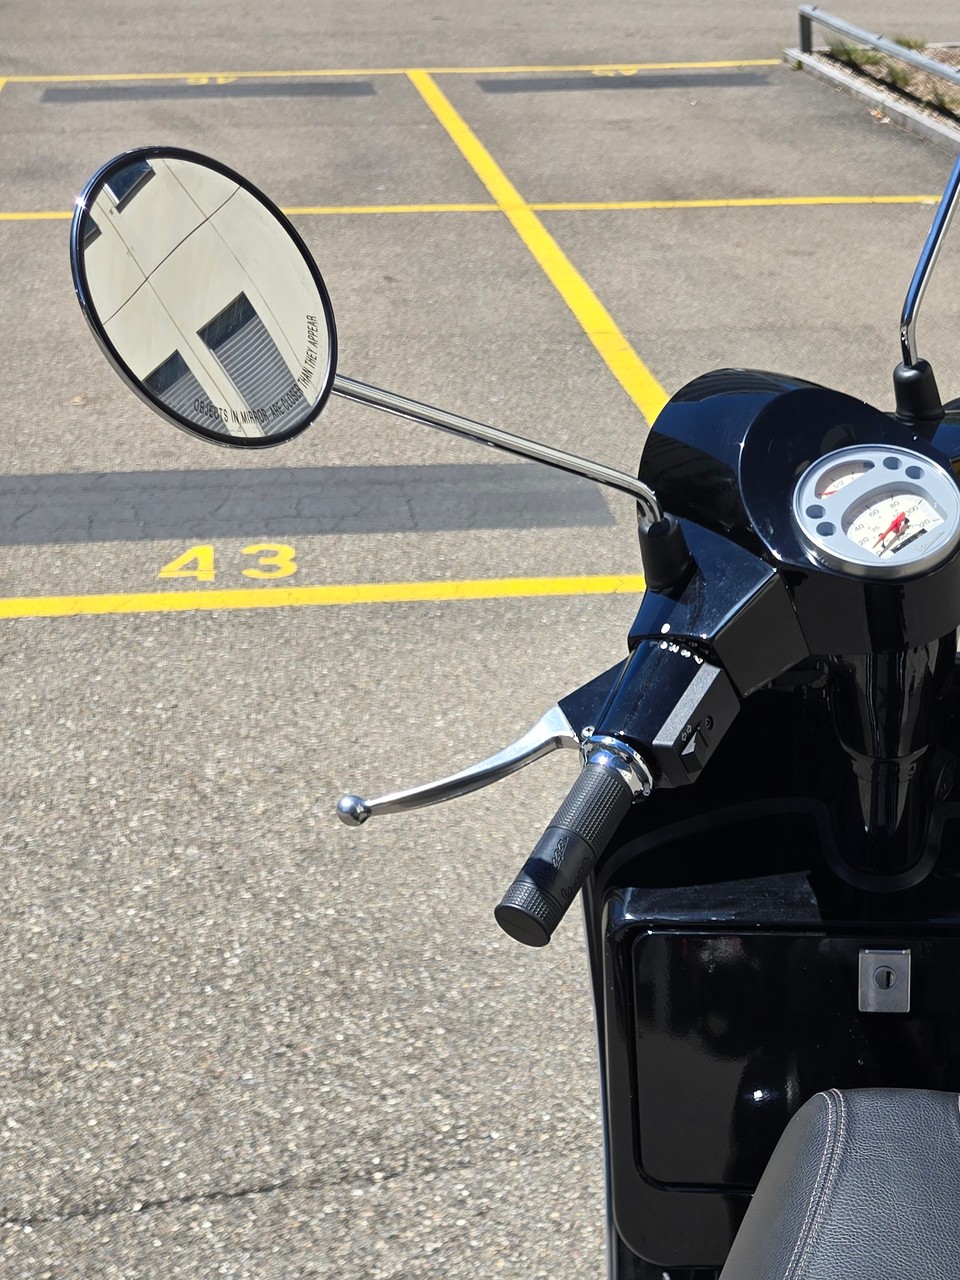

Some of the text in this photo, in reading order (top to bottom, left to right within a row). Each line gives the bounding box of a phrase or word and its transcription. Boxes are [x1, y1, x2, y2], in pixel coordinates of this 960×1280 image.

[193, 315, 319, 425] OBJECTS IN MIRROR ARE CLOSER THAN THEY APPEAR
[854, 523, 865, 532] 40
[859, 537, 870, 546] 20
[158, 543, 298, 582] 43
